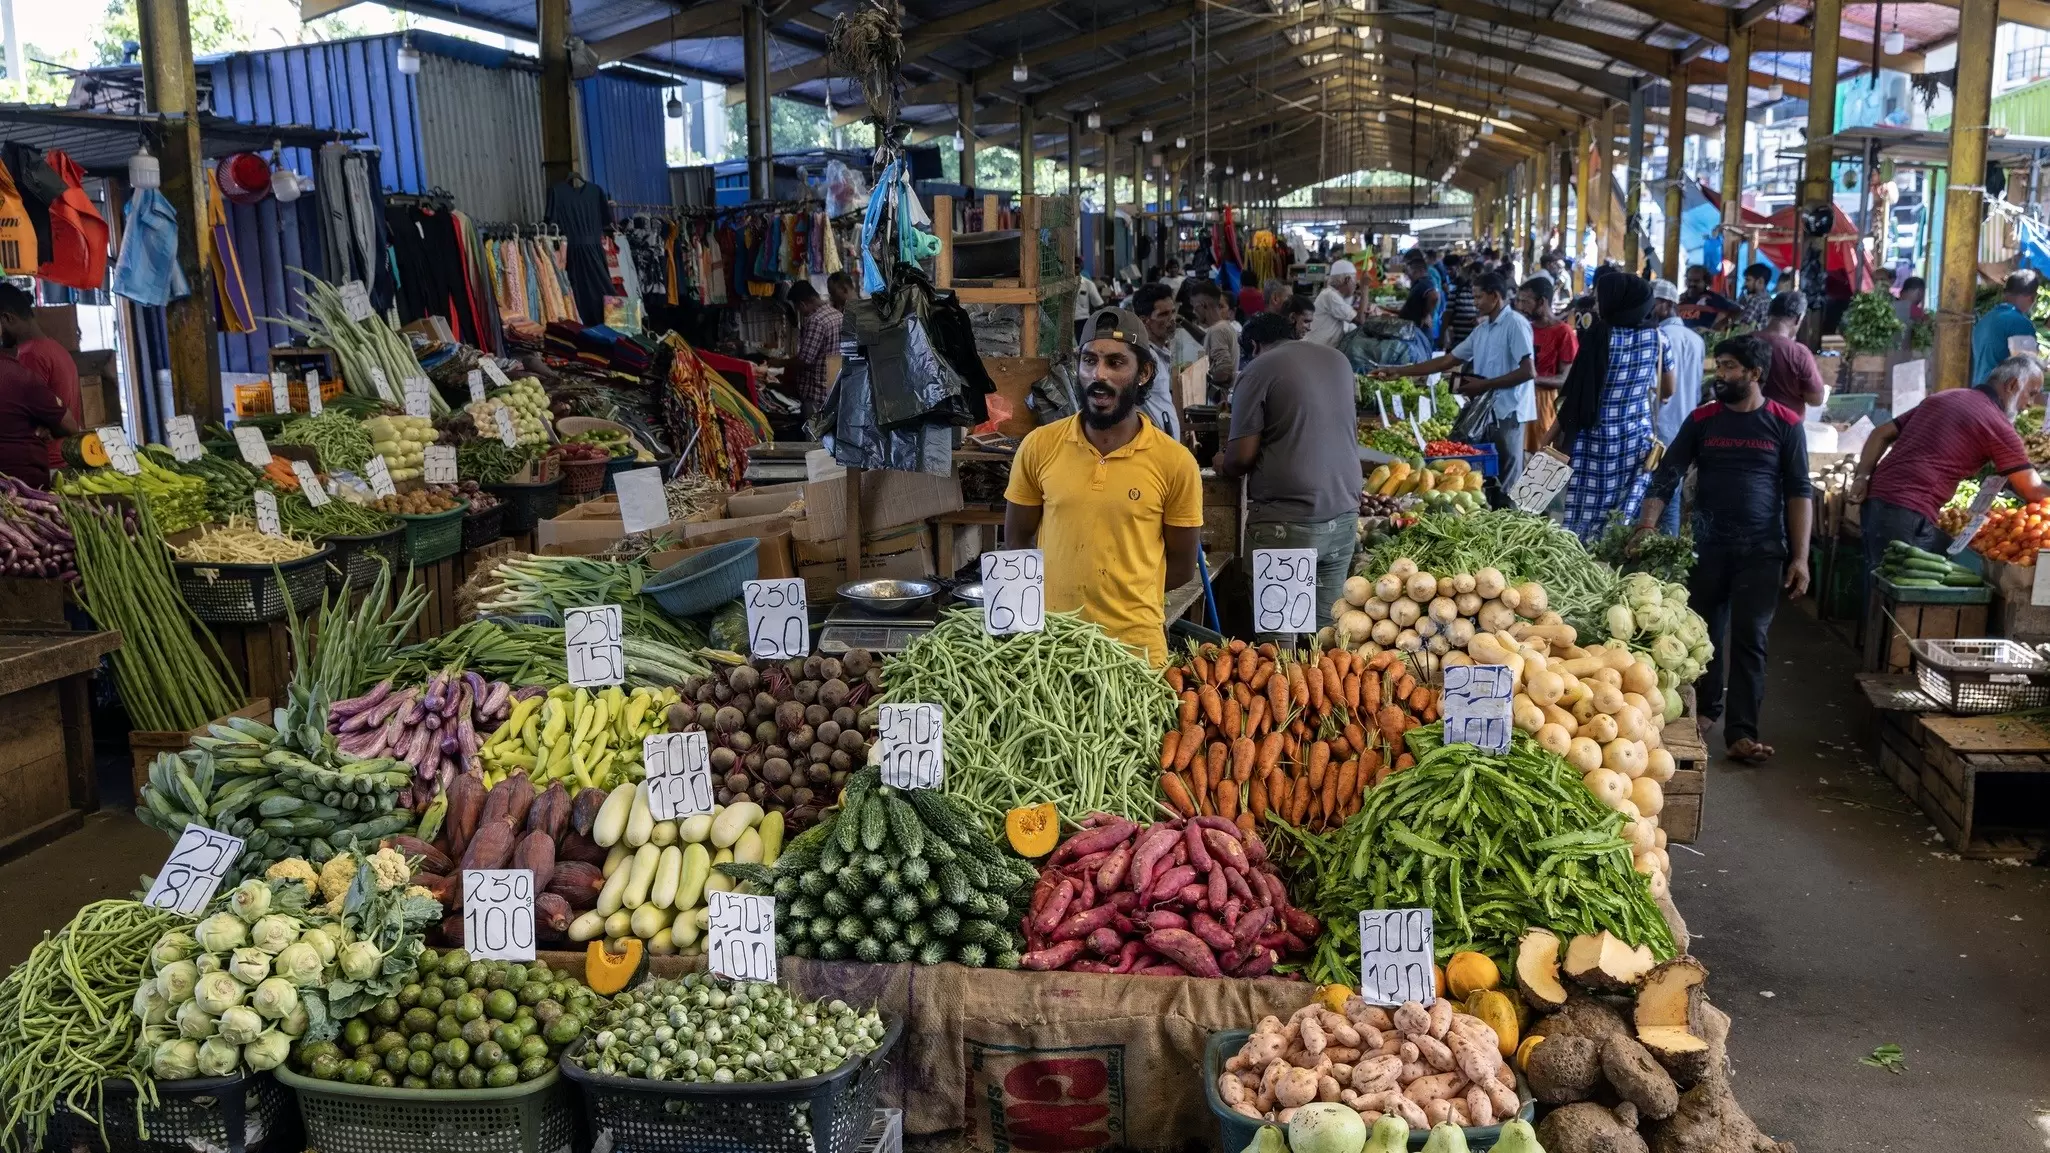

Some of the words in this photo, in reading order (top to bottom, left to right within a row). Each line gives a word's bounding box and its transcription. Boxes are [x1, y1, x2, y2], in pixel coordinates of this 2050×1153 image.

[984, 554, 1043, 584] 250g
[1257, 553, 1315, 587] 250g
[747, 582, 805, 610] 250g
[989, 585, 1041, 630] 60
[1259, 583, 1311, 631] 80
[753, 615, 803, 657] 60
[573, 644, 623, 683] 150
[880, 705, 941, 750] 250g
[645, 733, 709, 786] 500g
[167, 829, 242, 878] 250
[153, 869, 214, 916] 80
[467, 872, 532, 907] 250g
[466, 906, 534, 954] 100
[709, 891, 772, 937] 250g
[1363, 910, 1433, 959] 500g
